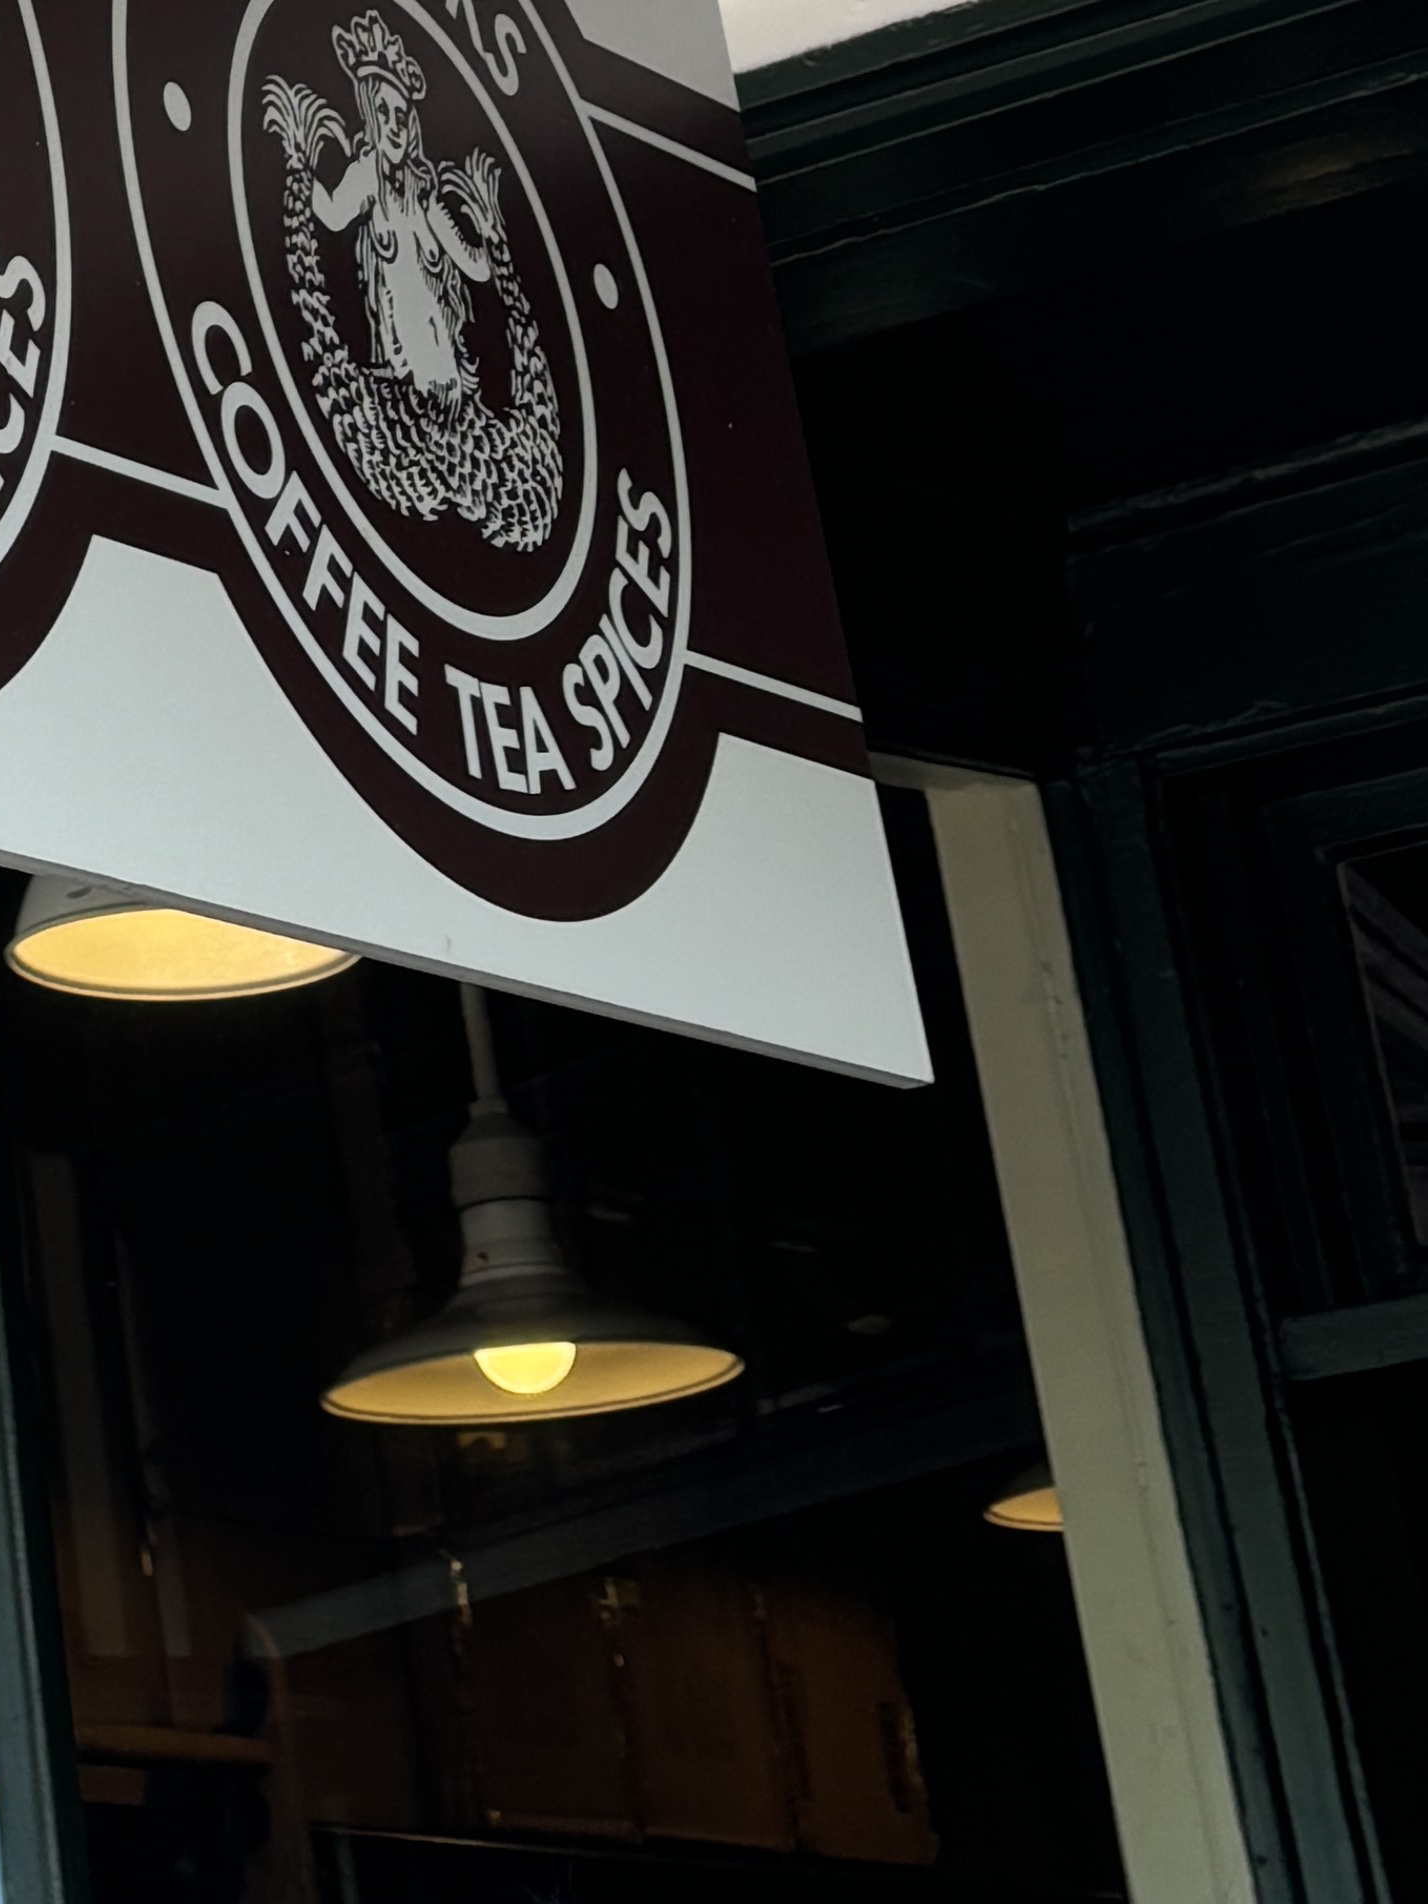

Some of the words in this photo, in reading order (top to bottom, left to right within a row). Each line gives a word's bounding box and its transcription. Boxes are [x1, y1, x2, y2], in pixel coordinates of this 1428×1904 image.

[191, 300, 419, 736] COFFEE
[444, 663, 576, 795] TEA
[562, 468, 672, 771] SPICES
